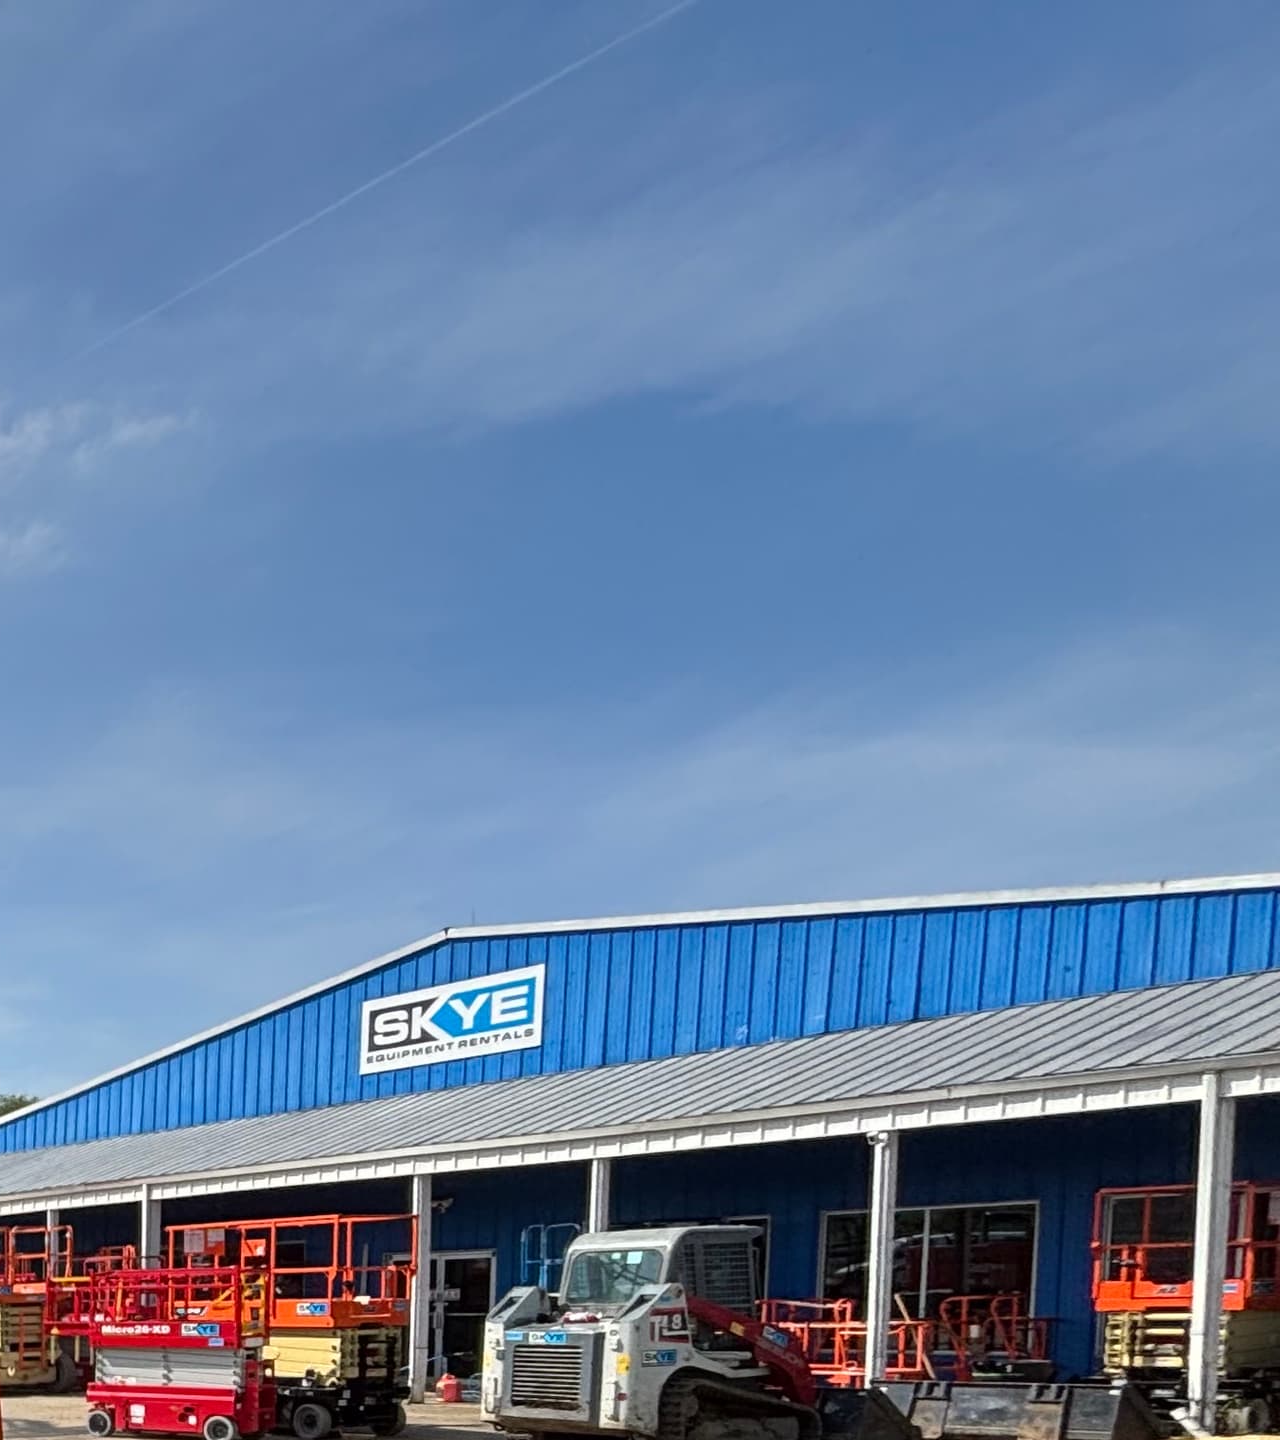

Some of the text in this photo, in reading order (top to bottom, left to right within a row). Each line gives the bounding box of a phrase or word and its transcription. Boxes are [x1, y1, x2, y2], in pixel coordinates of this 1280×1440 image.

[373, 985, 529, 1046] SKYE
[366, 1028, 535, 1065] EQUIPMENT RENTALS
[183, 1325, 217, 1333] SKYE
